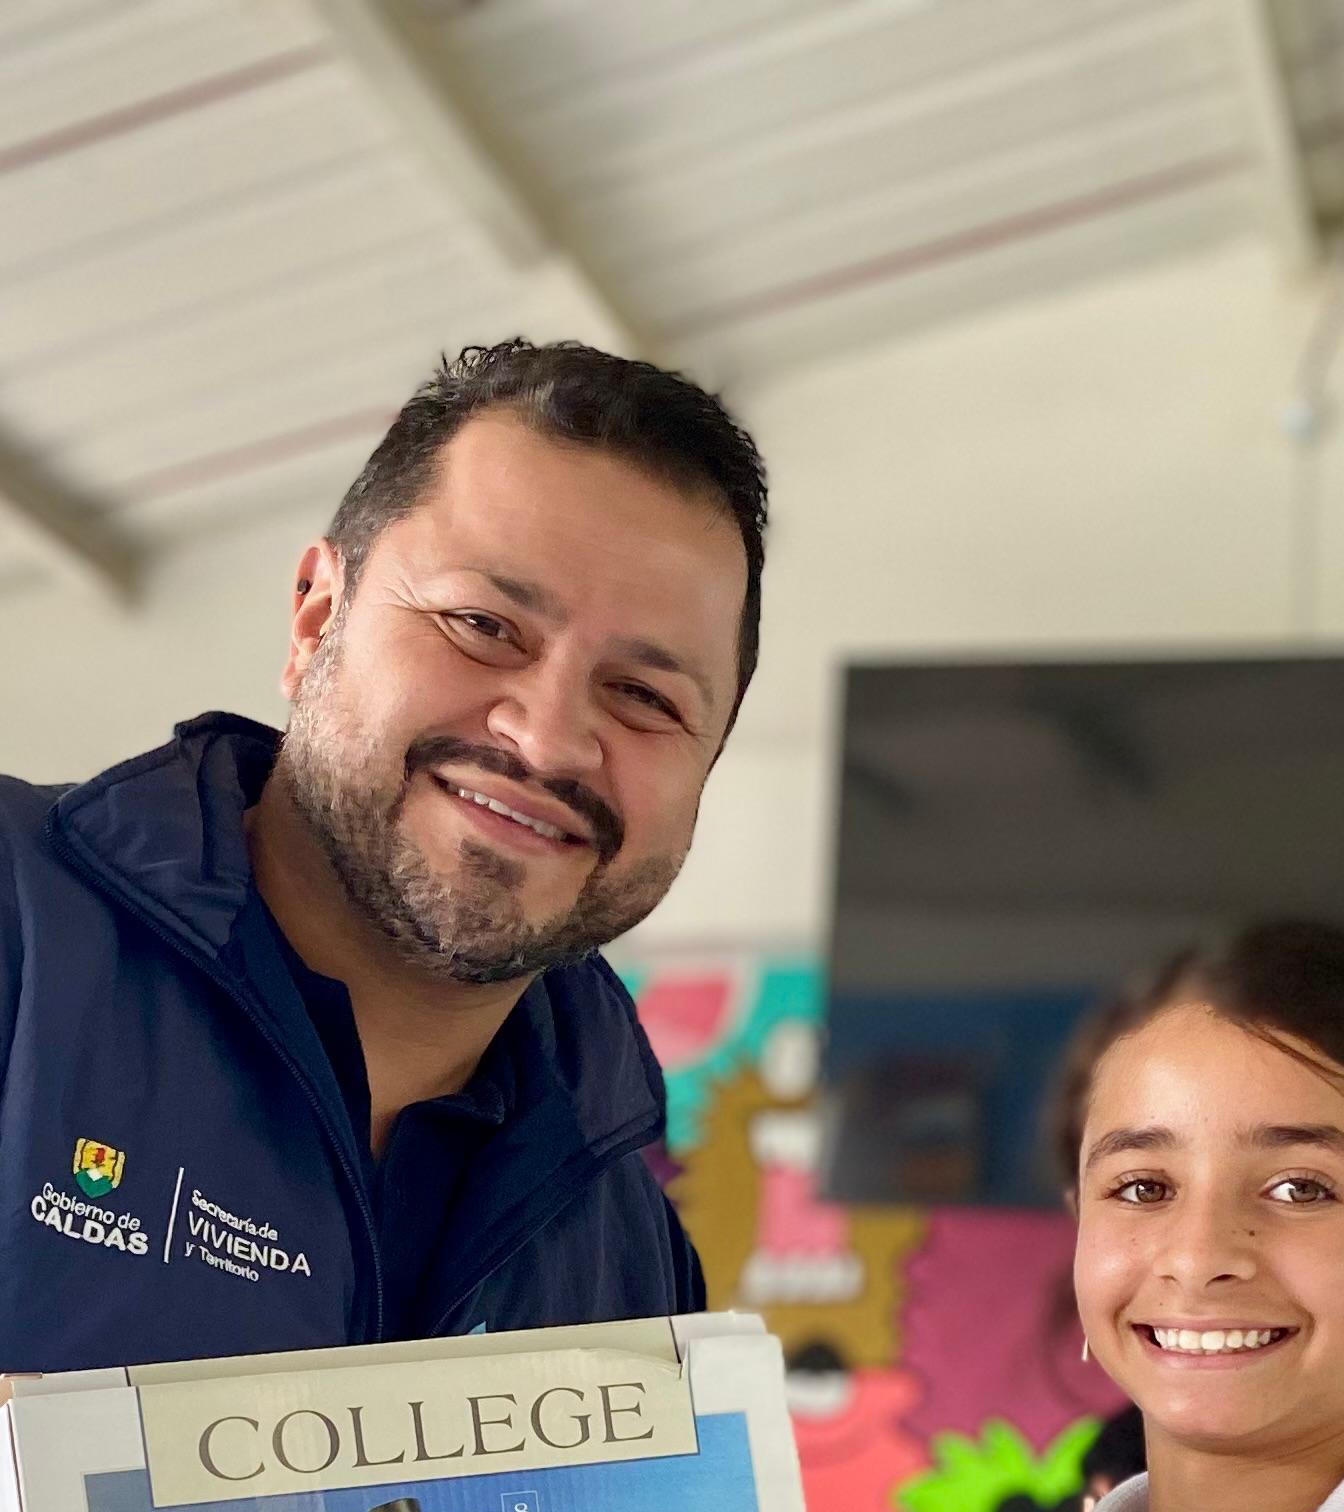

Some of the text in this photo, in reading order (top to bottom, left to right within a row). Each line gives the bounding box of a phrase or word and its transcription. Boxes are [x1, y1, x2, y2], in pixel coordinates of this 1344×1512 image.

[31, 1195, 149, 1255] CALDAS
[43, 1182, 140, 1231] Gobierno de
[192, 1189, 278, 1241] Secretaría de
[184, 1241, 260, 1282] y Territorio
[188, 1210, 311, 1277] VIVIENDA
[198, 1382, 654, 1481] COLLEGE
